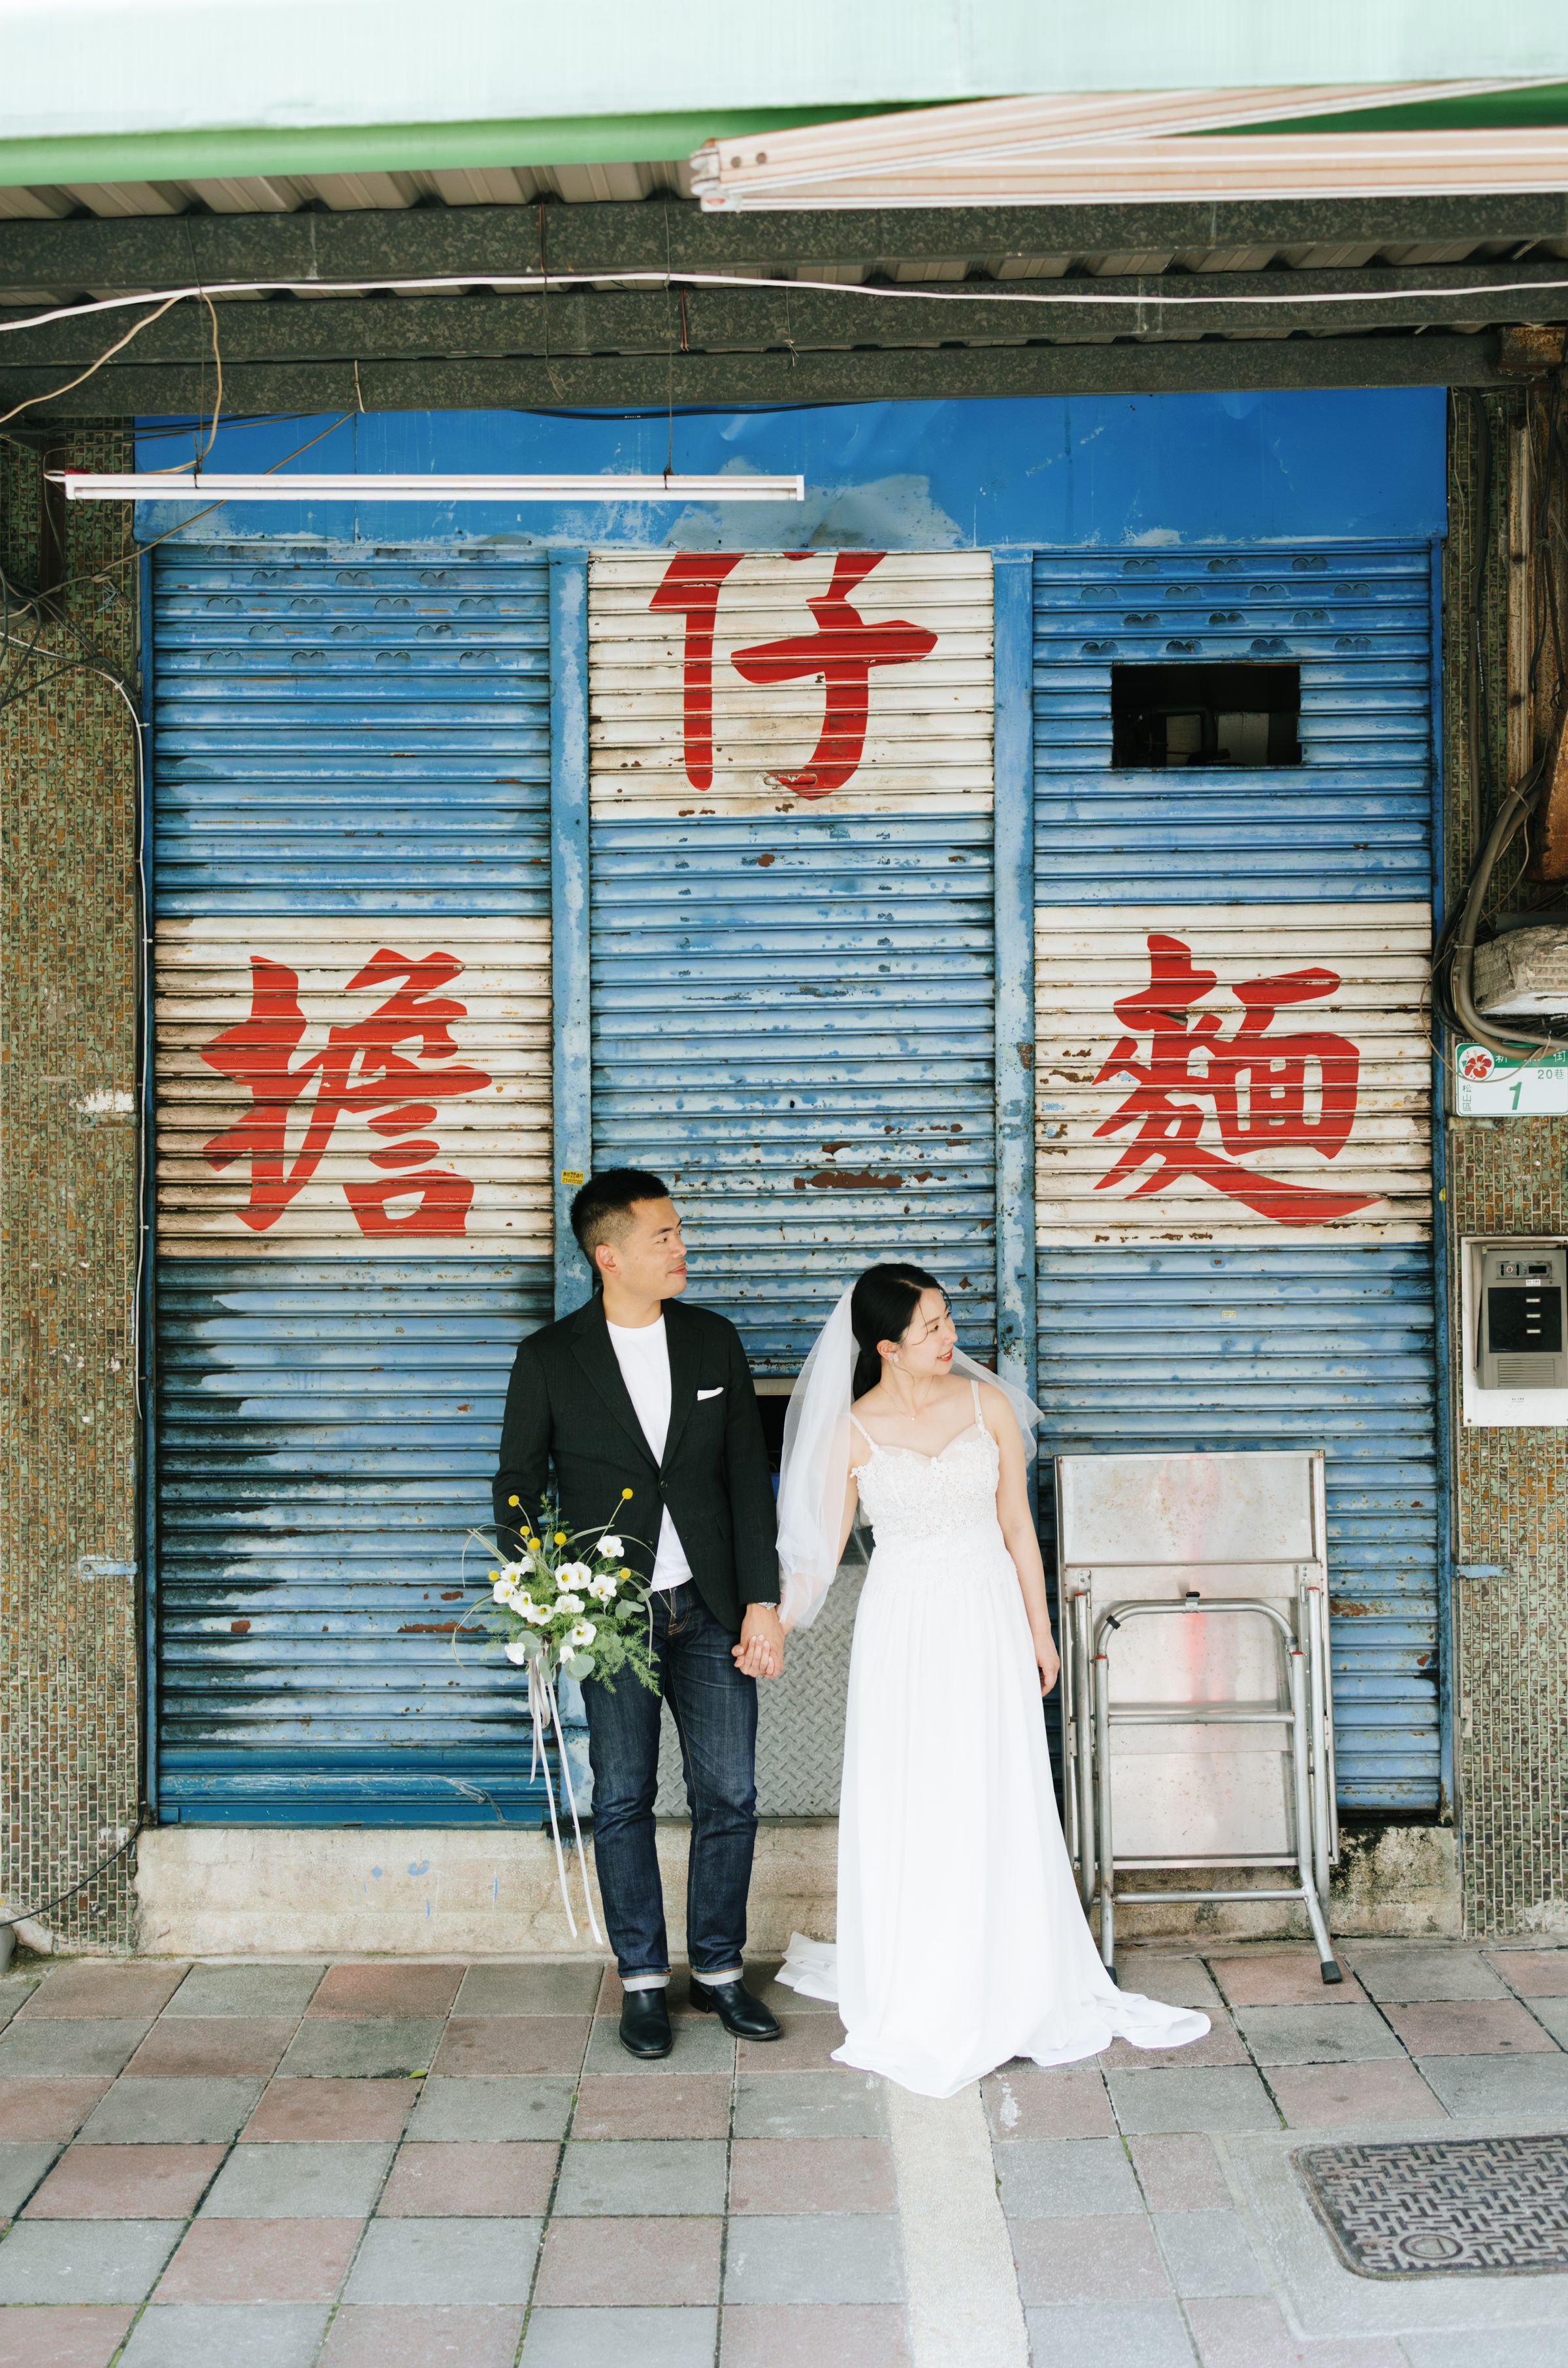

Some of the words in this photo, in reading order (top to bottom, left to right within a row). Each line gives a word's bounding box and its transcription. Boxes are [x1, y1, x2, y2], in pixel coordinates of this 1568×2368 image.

[197, 947, 493, 1238] 擔
[648, 551, 939, 800] 仔
[1091, 934, 1386, 1228] 麵
[1537, 1068, 1565, 1079] 20巷
[1462, 1084, 1472, 1111] 松山區
[1509, 1081, 1522, 1110] 1
